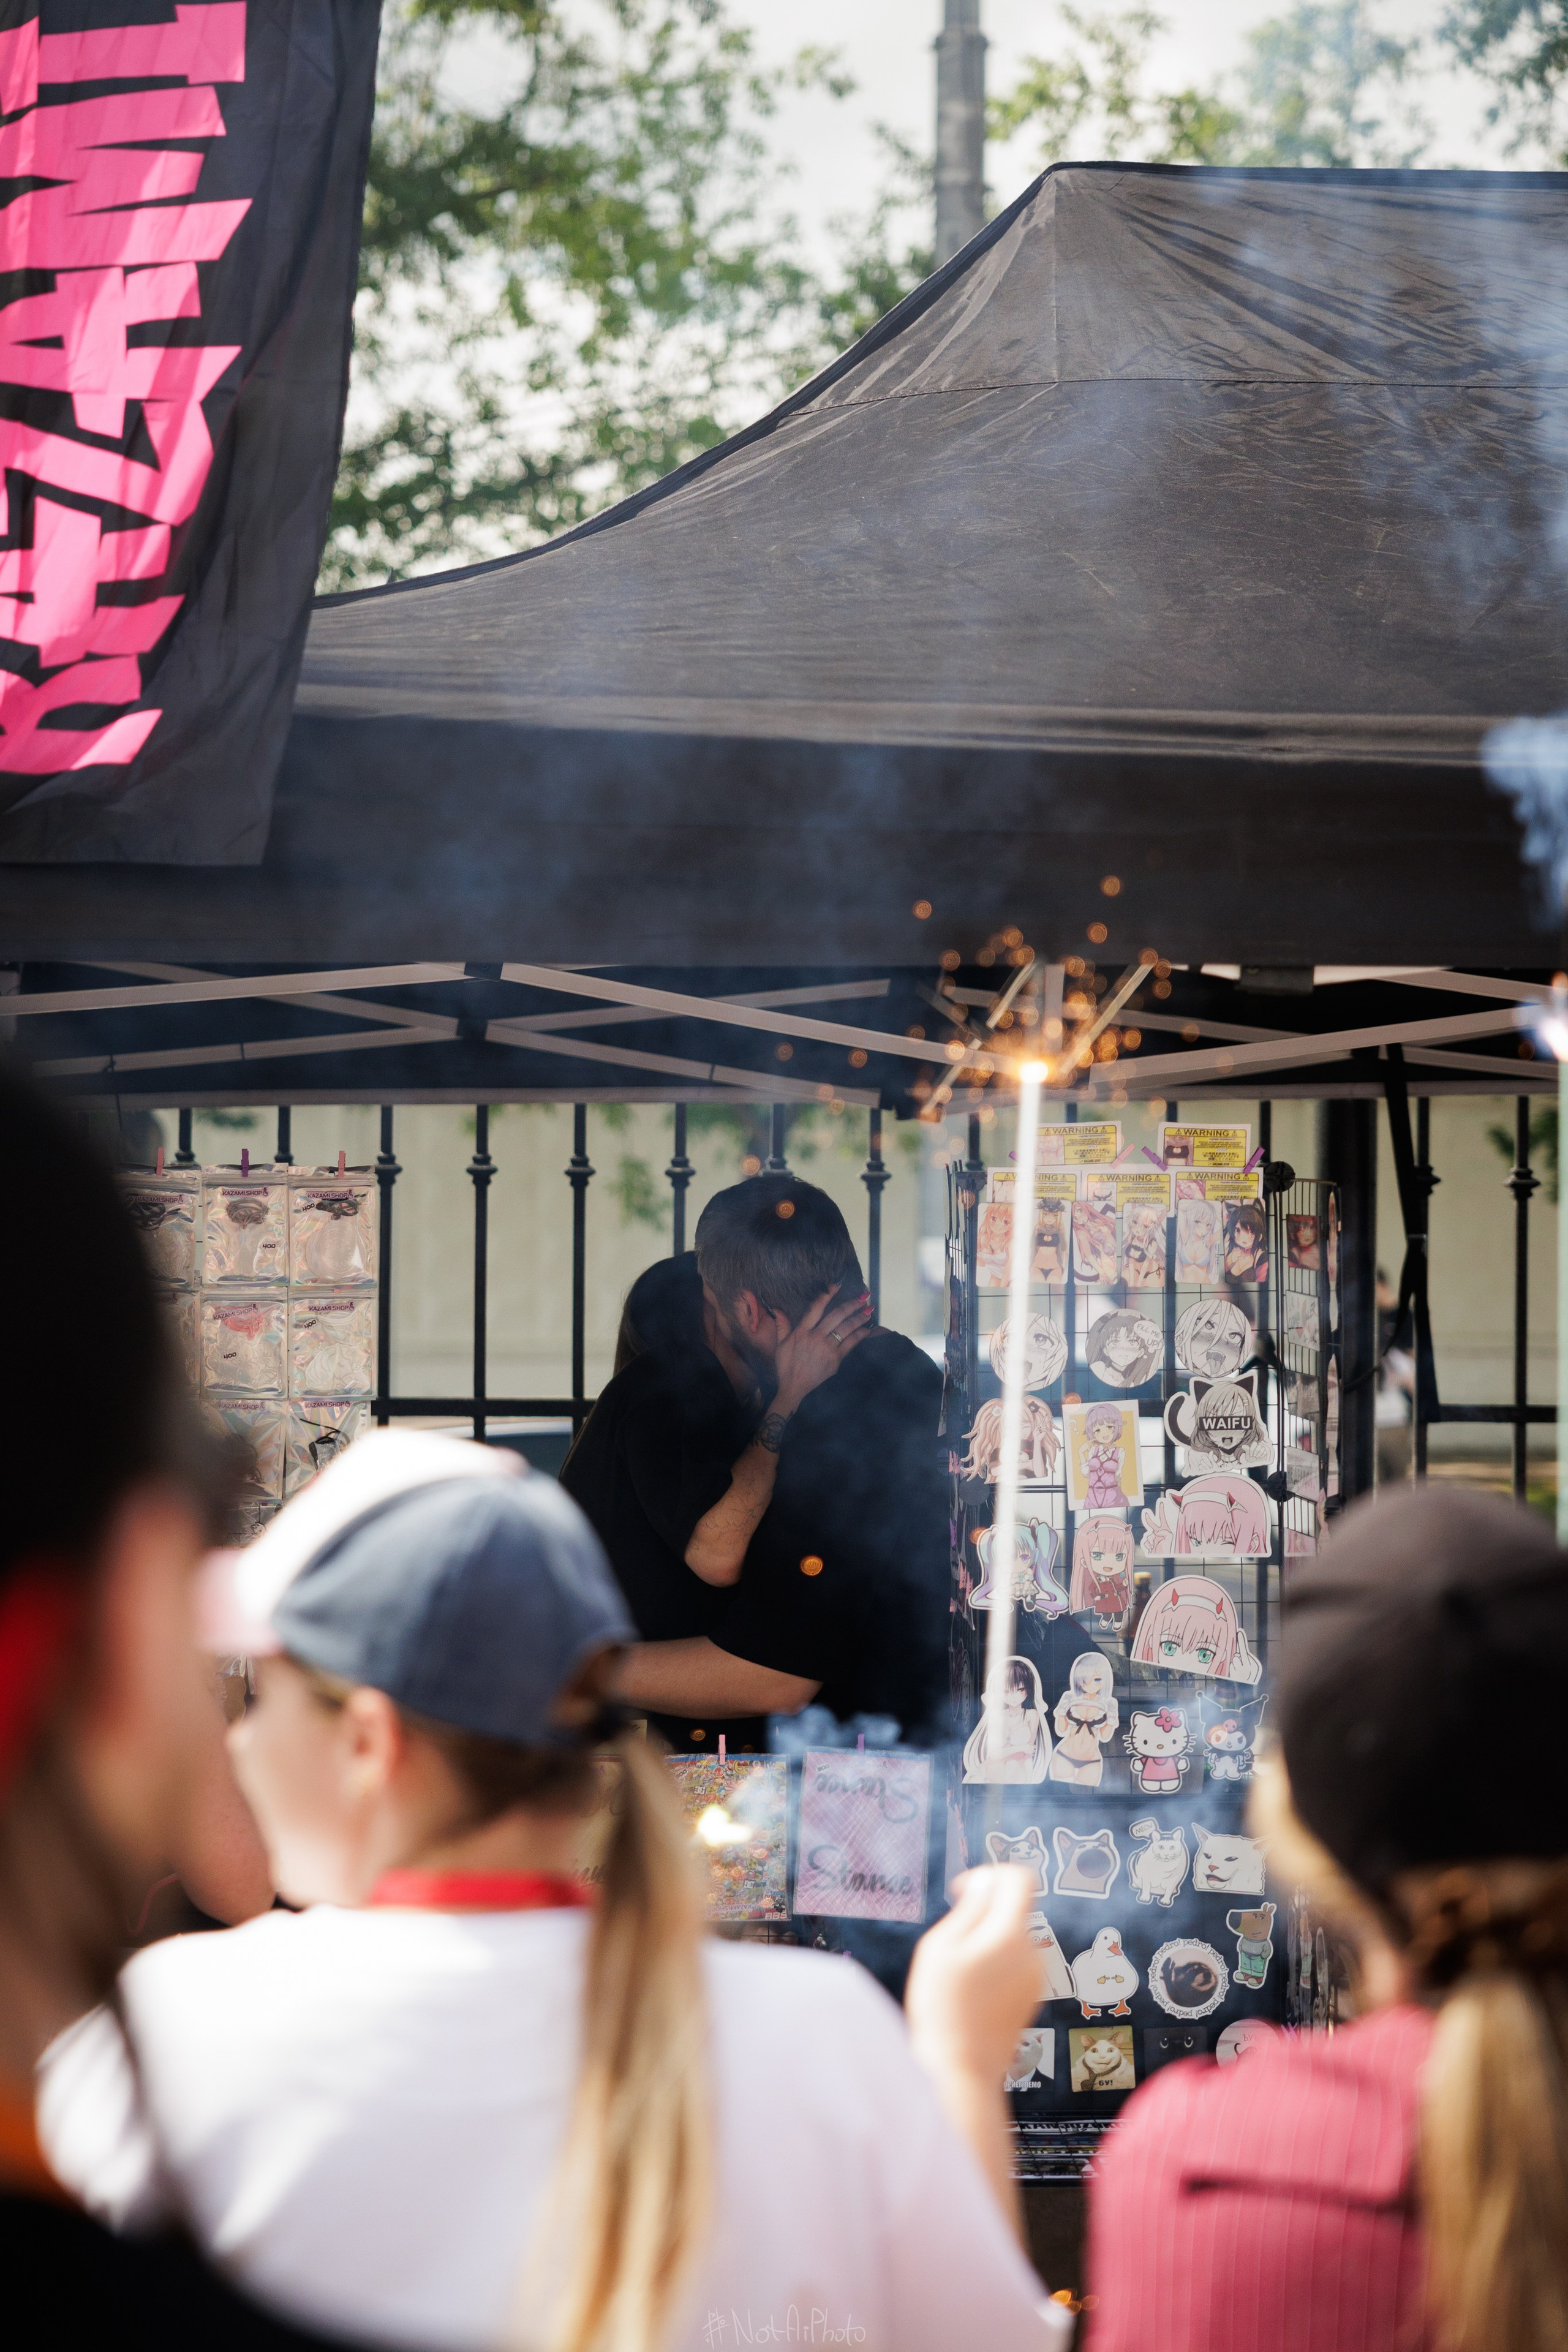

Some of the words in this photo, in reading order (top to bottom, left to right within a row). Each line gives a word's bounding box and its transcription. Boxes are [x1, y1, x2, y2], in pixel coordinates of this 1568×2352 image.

[303, 1203, 315, 1212] 400
[304, 1319, 316, 1329] 400
[1137, 1324, 1148, 1332] FILL
[1202, 1417, 1251, 1430] WAIFU
[1135, 1823, 1153, 1835] MEOW
[1158, 1939, 1181, 1958] pedro!
[1183, 1938, 1210, 1950] pedro!
[1208, 1948, 1228, 1971] pedro!
[1150, 1956, 1160, 1982] pedro!
[1219, 1972, 1227, 2000] pedro!
[1150, 1985, 1170, 2007] pedro!
[1167, 2006, 1193, 2017] pedro!
[1196, 1997, 1220, 2017] pedro!
